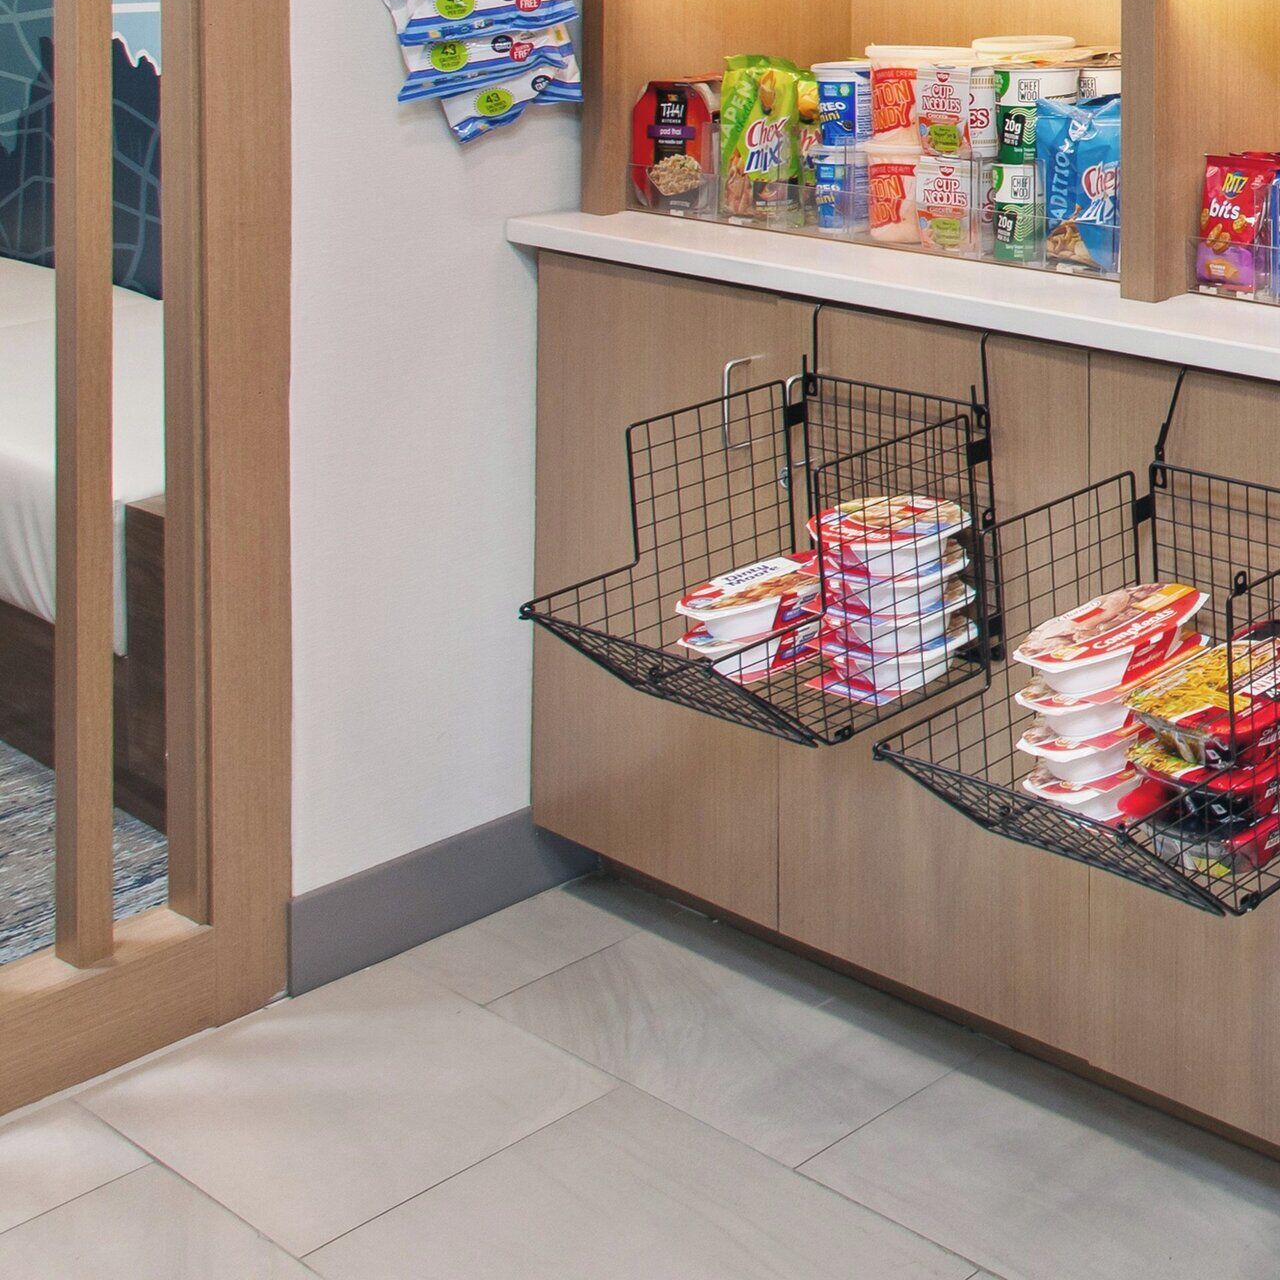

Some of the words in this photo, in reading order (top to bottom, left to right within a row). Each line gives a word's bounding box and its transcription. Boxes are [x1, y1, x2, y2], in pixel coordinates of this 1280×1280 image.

[931, 84, 954, 96] CUP
[1020, 81, 1037, 91] CHEF
[661, 102, 684, 117] THAI
[922, 96, 961, 113] NOODLES
[747, 117, 789, 147] Chex
[1004, 119, 1021, 135] 20g
[934, 179, 959, 192] CUP
[1012, 178, 1029, 188] CHEF
[1222, 172, 1248, 193] RITZ
[923, 189, 967, 206] NOODLES
[1209, 200, 1240, 220] bits
[998, 216, 1013, 231] 20g
[1092, 607, 1178, 649] Compleats
